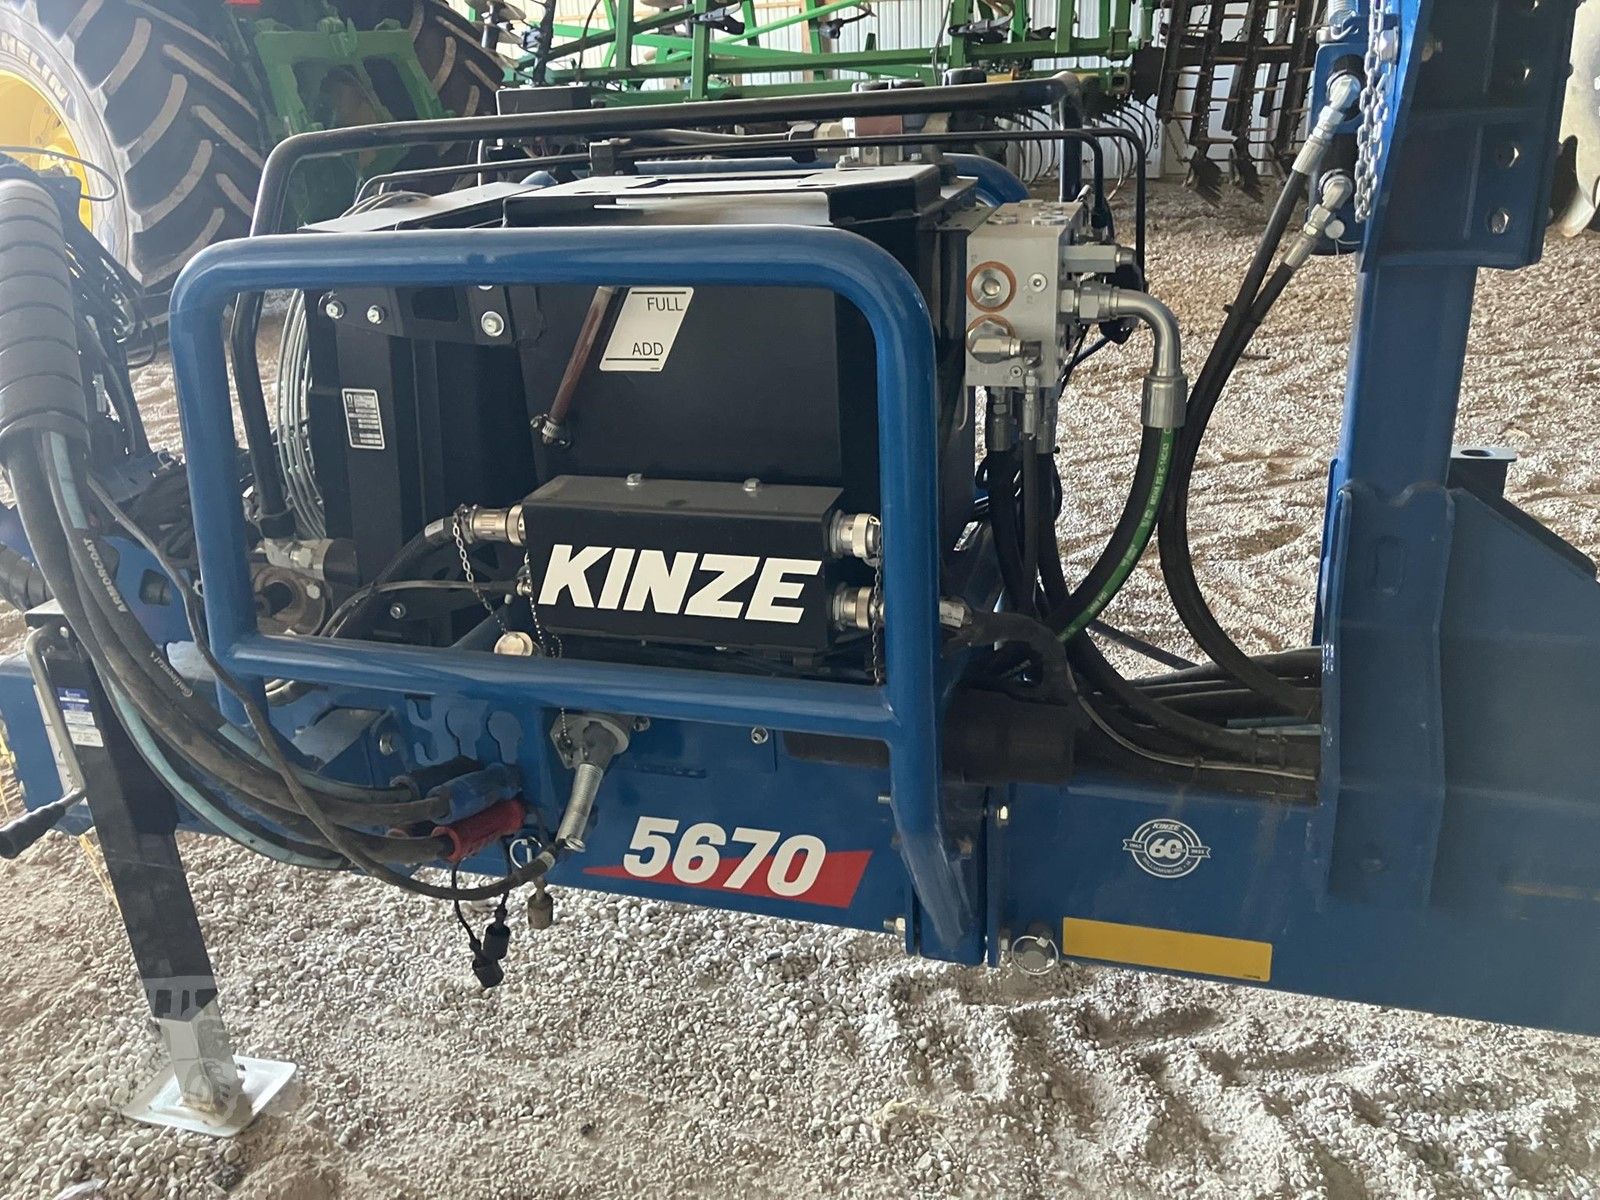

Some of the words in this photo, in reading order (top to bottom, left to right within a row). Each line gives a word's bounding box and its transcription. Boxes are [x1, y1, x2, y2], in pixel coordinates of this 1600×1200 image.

[646, 296, 685, 312] FULL
[631, 341, 664, 356] ADD
[83, 537, 129, 613] ARMORCOAT
[537, 543, 823, 624] KINZE
[1152, 822, 1181, 831] KINZE
[622, 815, 827, 897] 5670
[1149, 838, 1183, 860] 60
